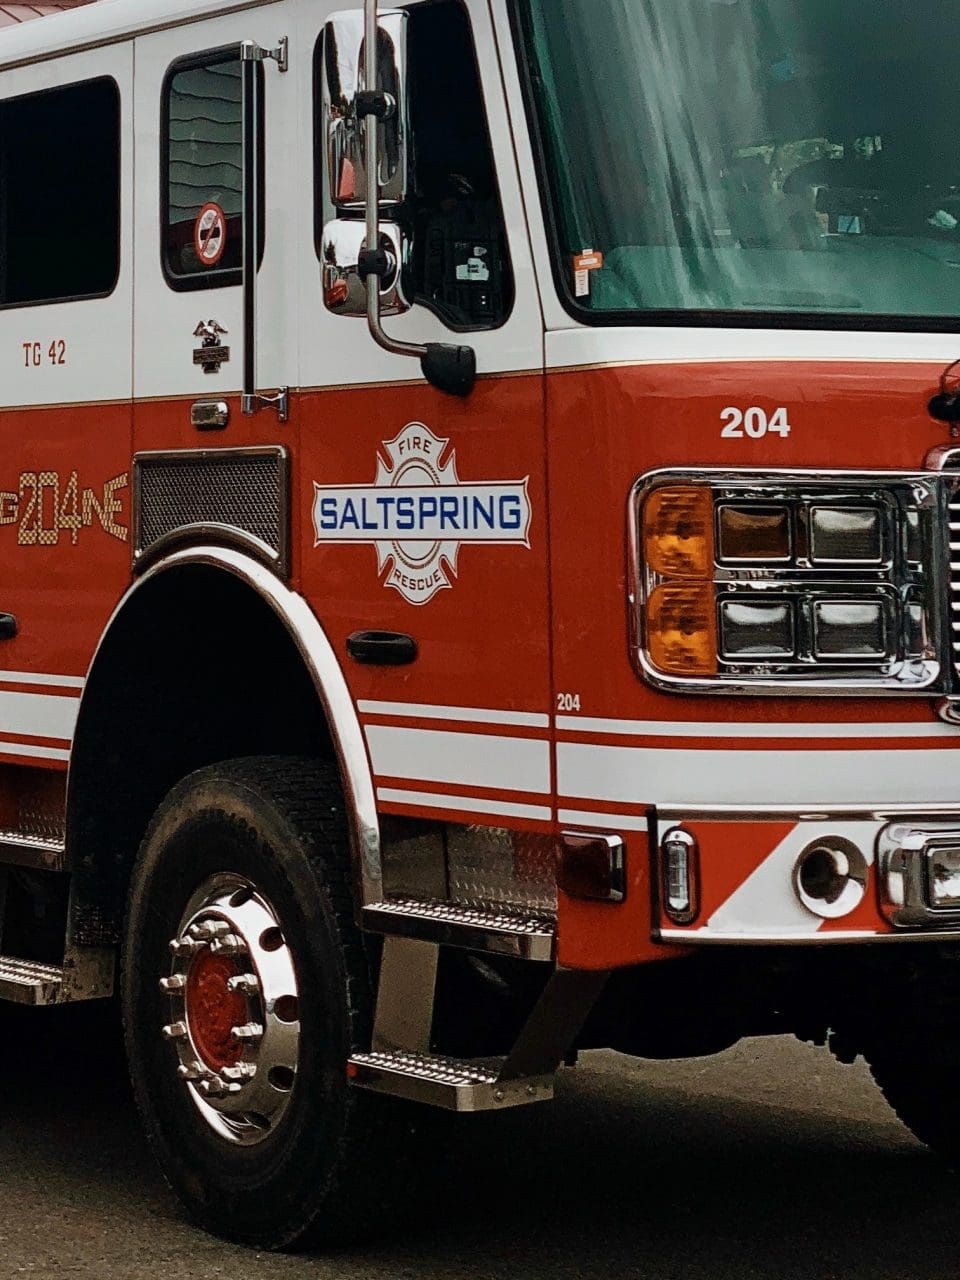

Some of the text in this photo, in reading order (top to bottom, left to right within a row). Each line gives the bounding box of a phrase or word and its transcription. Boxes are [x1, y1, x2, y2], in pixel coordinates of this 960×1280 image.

[22, 339, 66, 367] TG 42
[720, 408, 790, 438] 204
[398, 436, 431, 455] FIRE
[320, 495, 521, 530] SALTSPRING
[392, 569, 441, 591] RESCUE
[557, 693, 581, 711] 204
